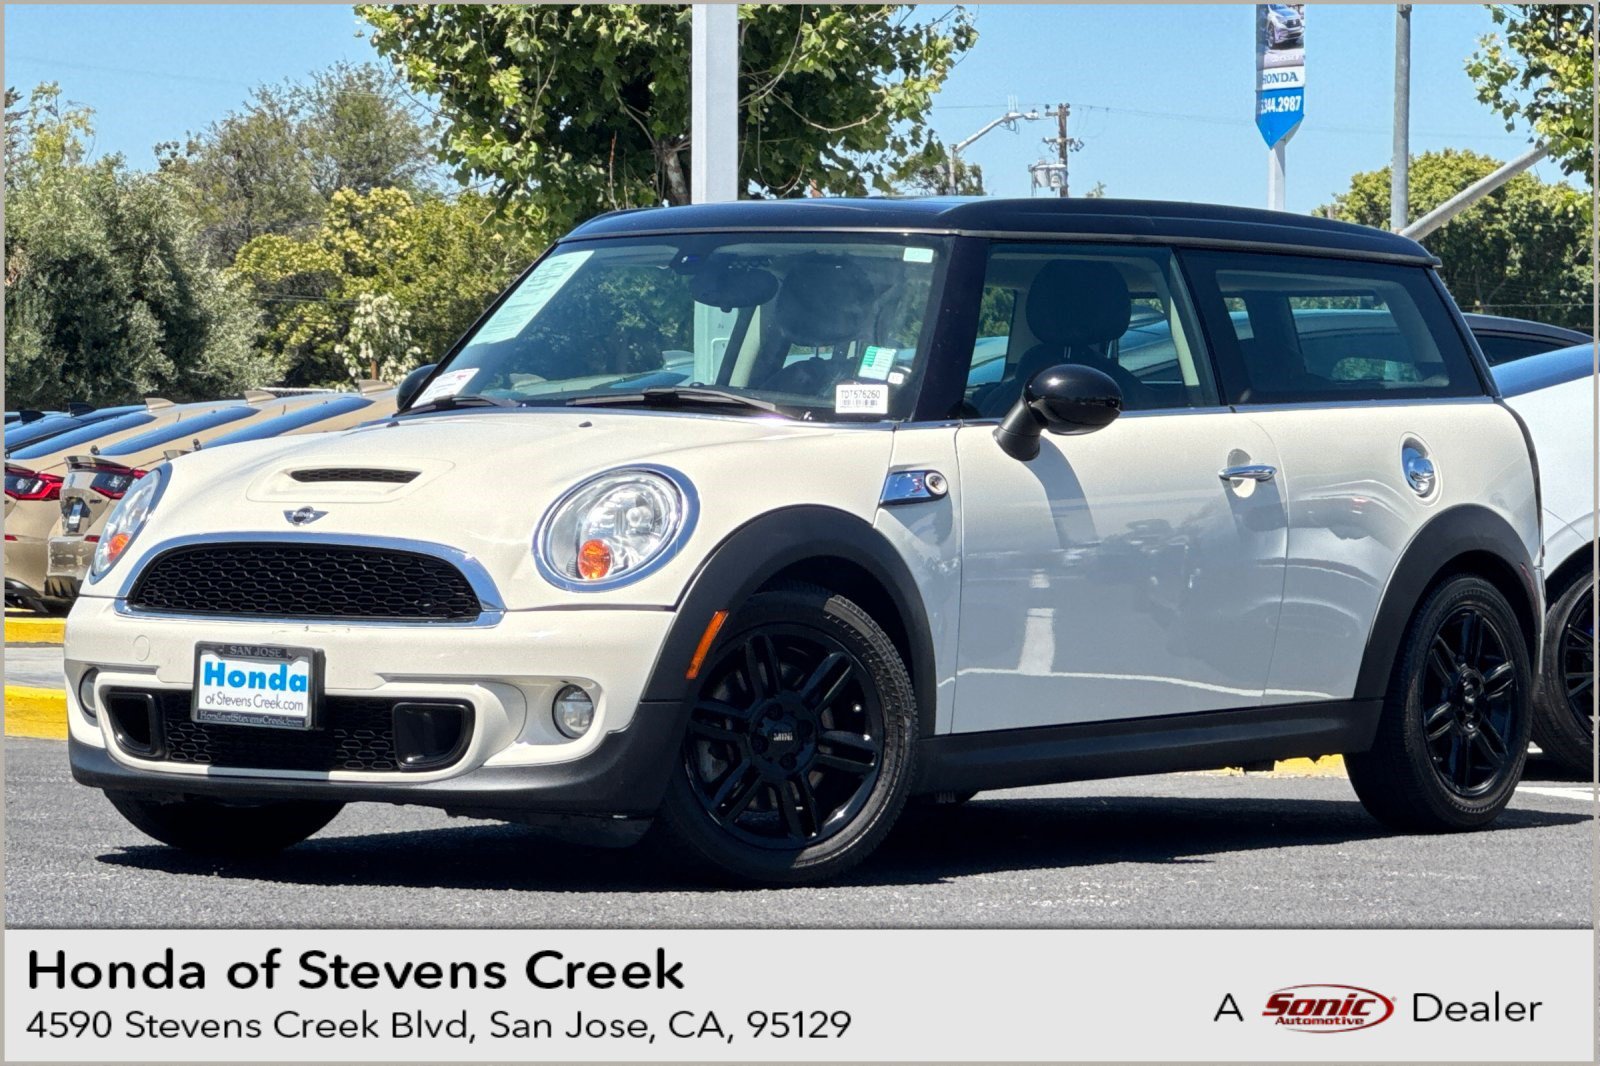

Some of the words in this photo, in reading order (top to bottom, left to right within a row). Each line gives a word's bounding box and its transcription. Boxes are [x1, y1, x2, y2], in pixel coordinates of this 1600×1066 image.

[229, 645, 253, 656] SAN
[254, 647, 283, 658] JOSE
[204, 662, 306, 692] Honda
[205, 692, 216, 705] of
[773, 732, 793, 741] MINI
